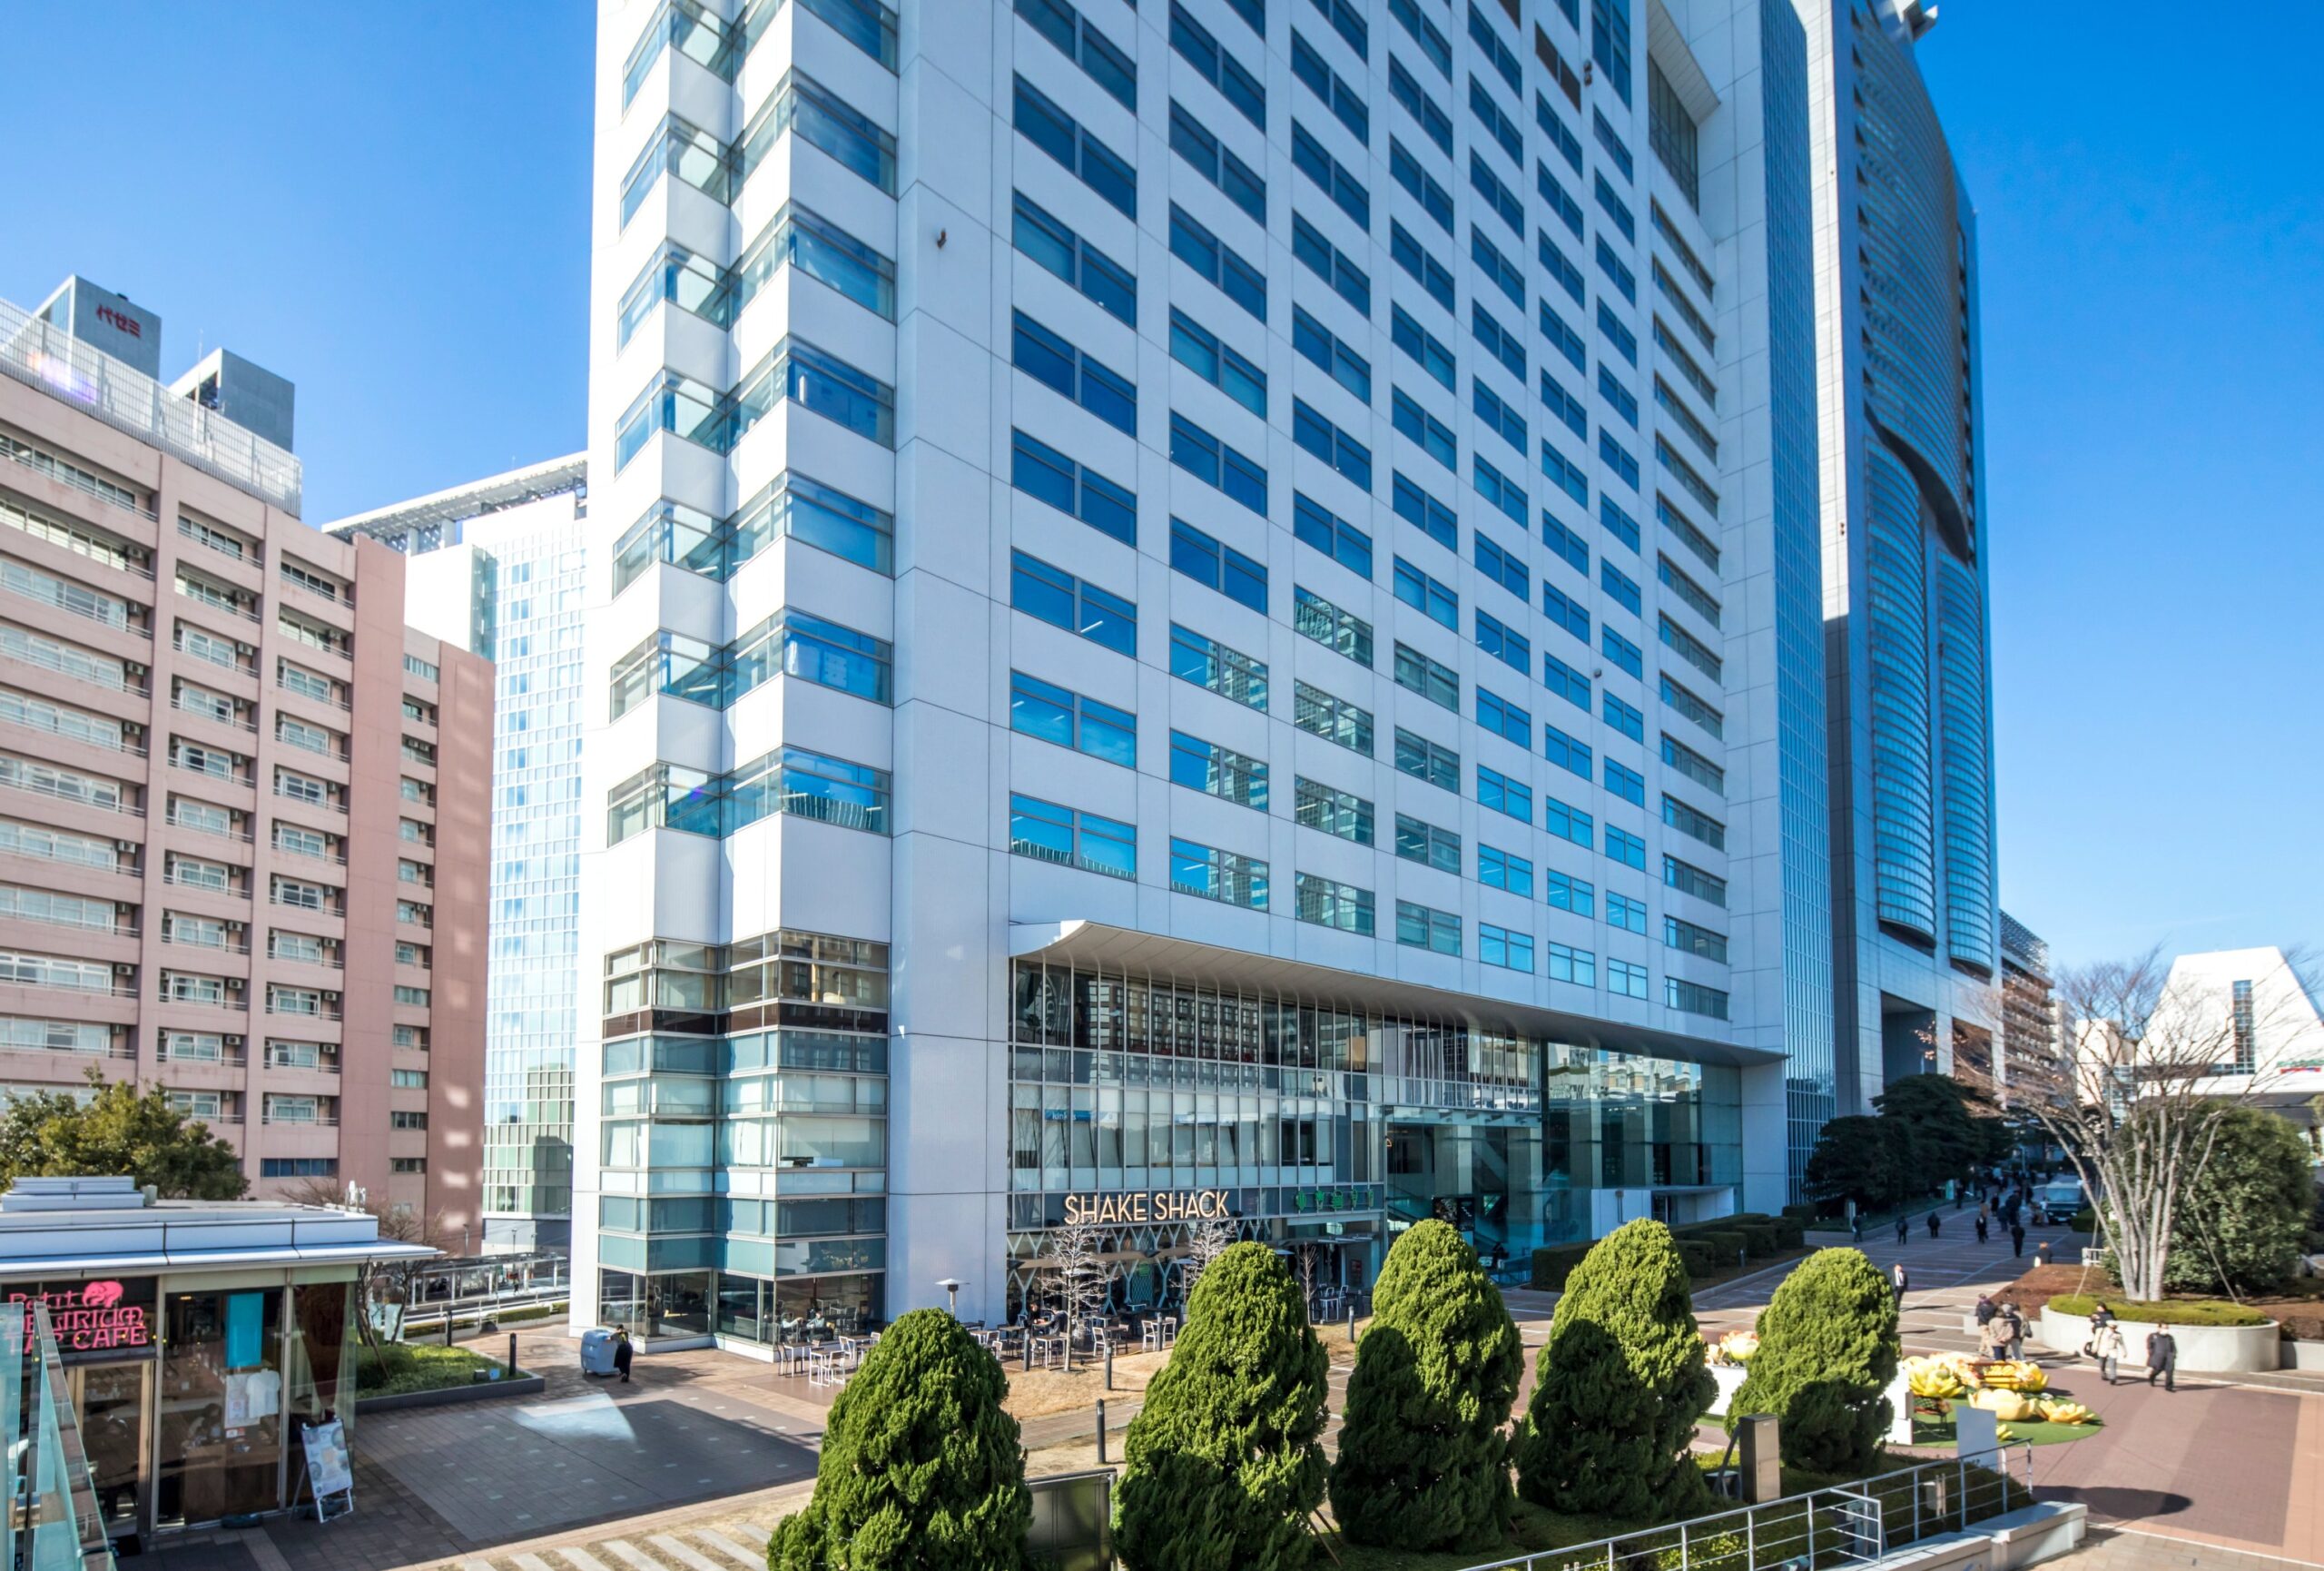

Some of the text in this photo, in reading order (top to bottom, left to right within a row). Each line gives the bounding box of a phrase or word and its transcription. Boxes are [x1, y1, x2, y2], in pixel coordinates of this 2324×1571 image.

[96, 303, 141, 339] 代ゼミ
[1064, 1191, 1229, 1225] SHAKE SHACK
[9, 1307, 146, 1334] ELIRIUM
[74, 1327, 148, 1350] CAFE
